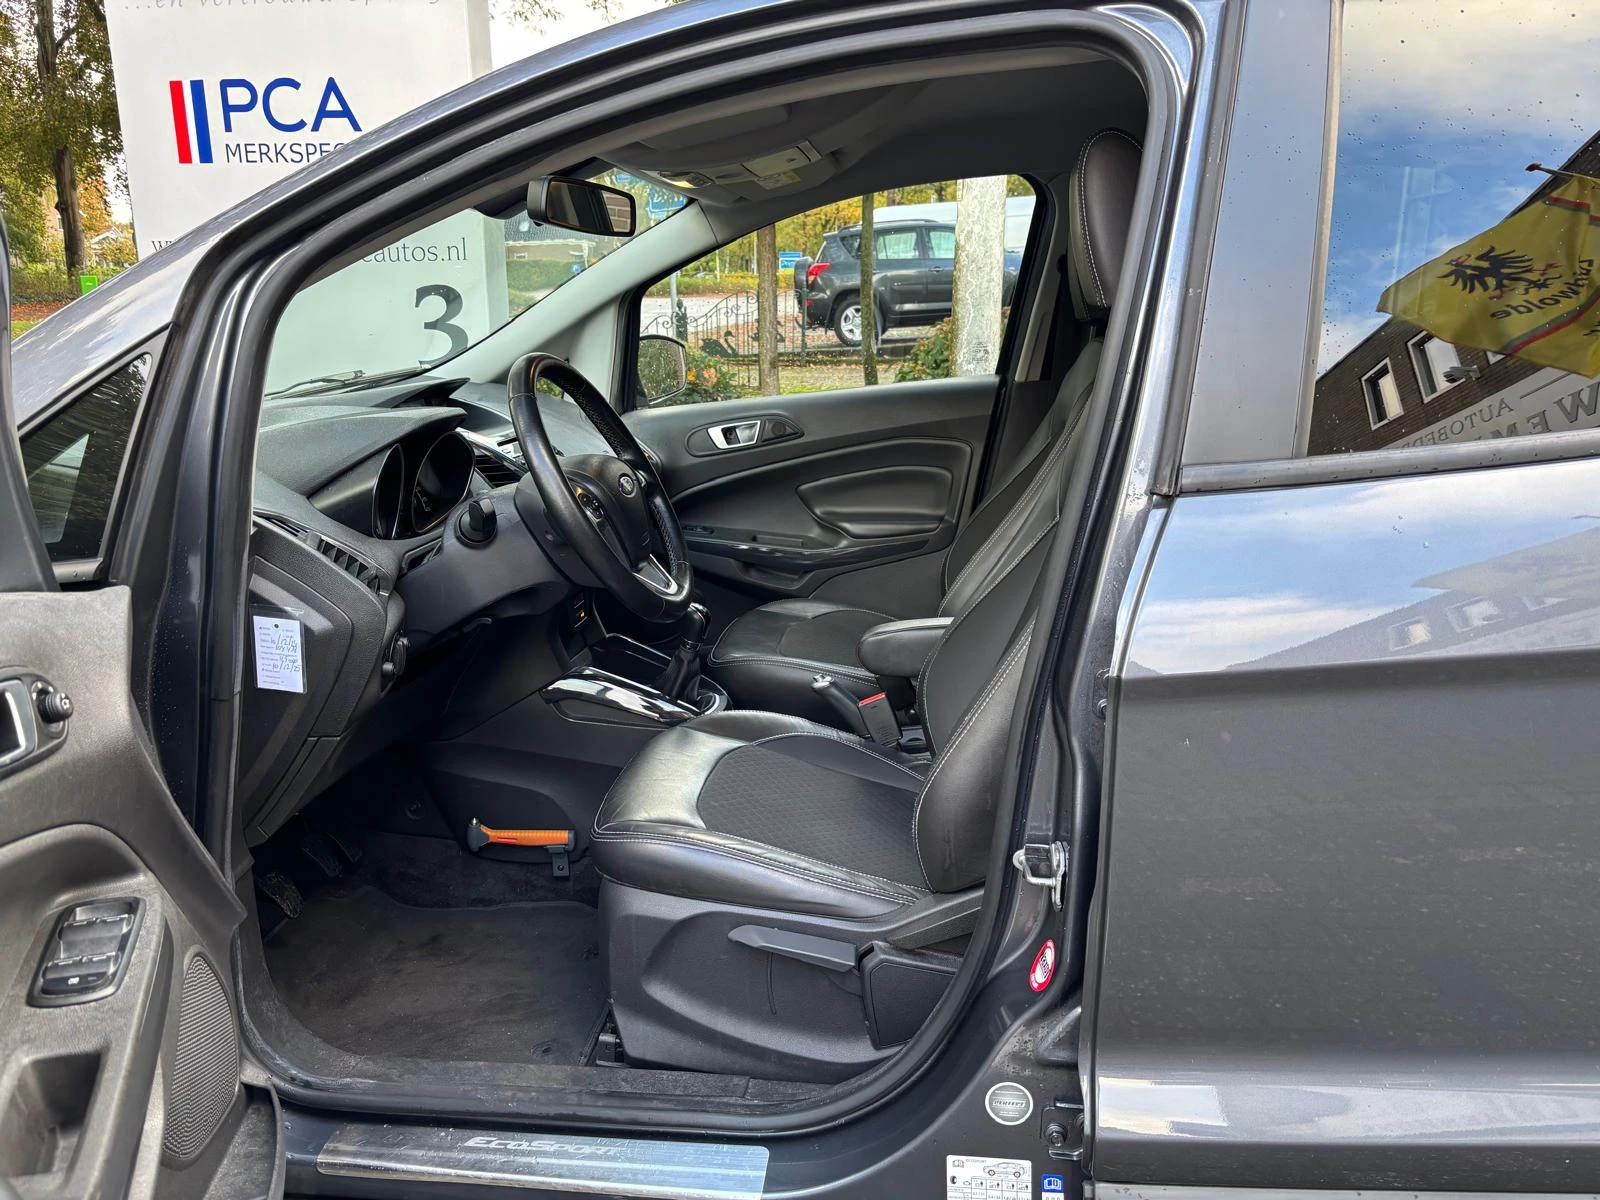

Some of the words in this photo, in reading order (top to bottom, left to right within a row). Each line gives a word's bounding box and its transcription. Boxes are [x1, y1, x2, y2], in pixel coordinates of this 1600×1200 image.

[219, 76, 363, 133] PCA
[225, 142, 346, 164] MERKSPE
[414, 283, 469, 368] 3
